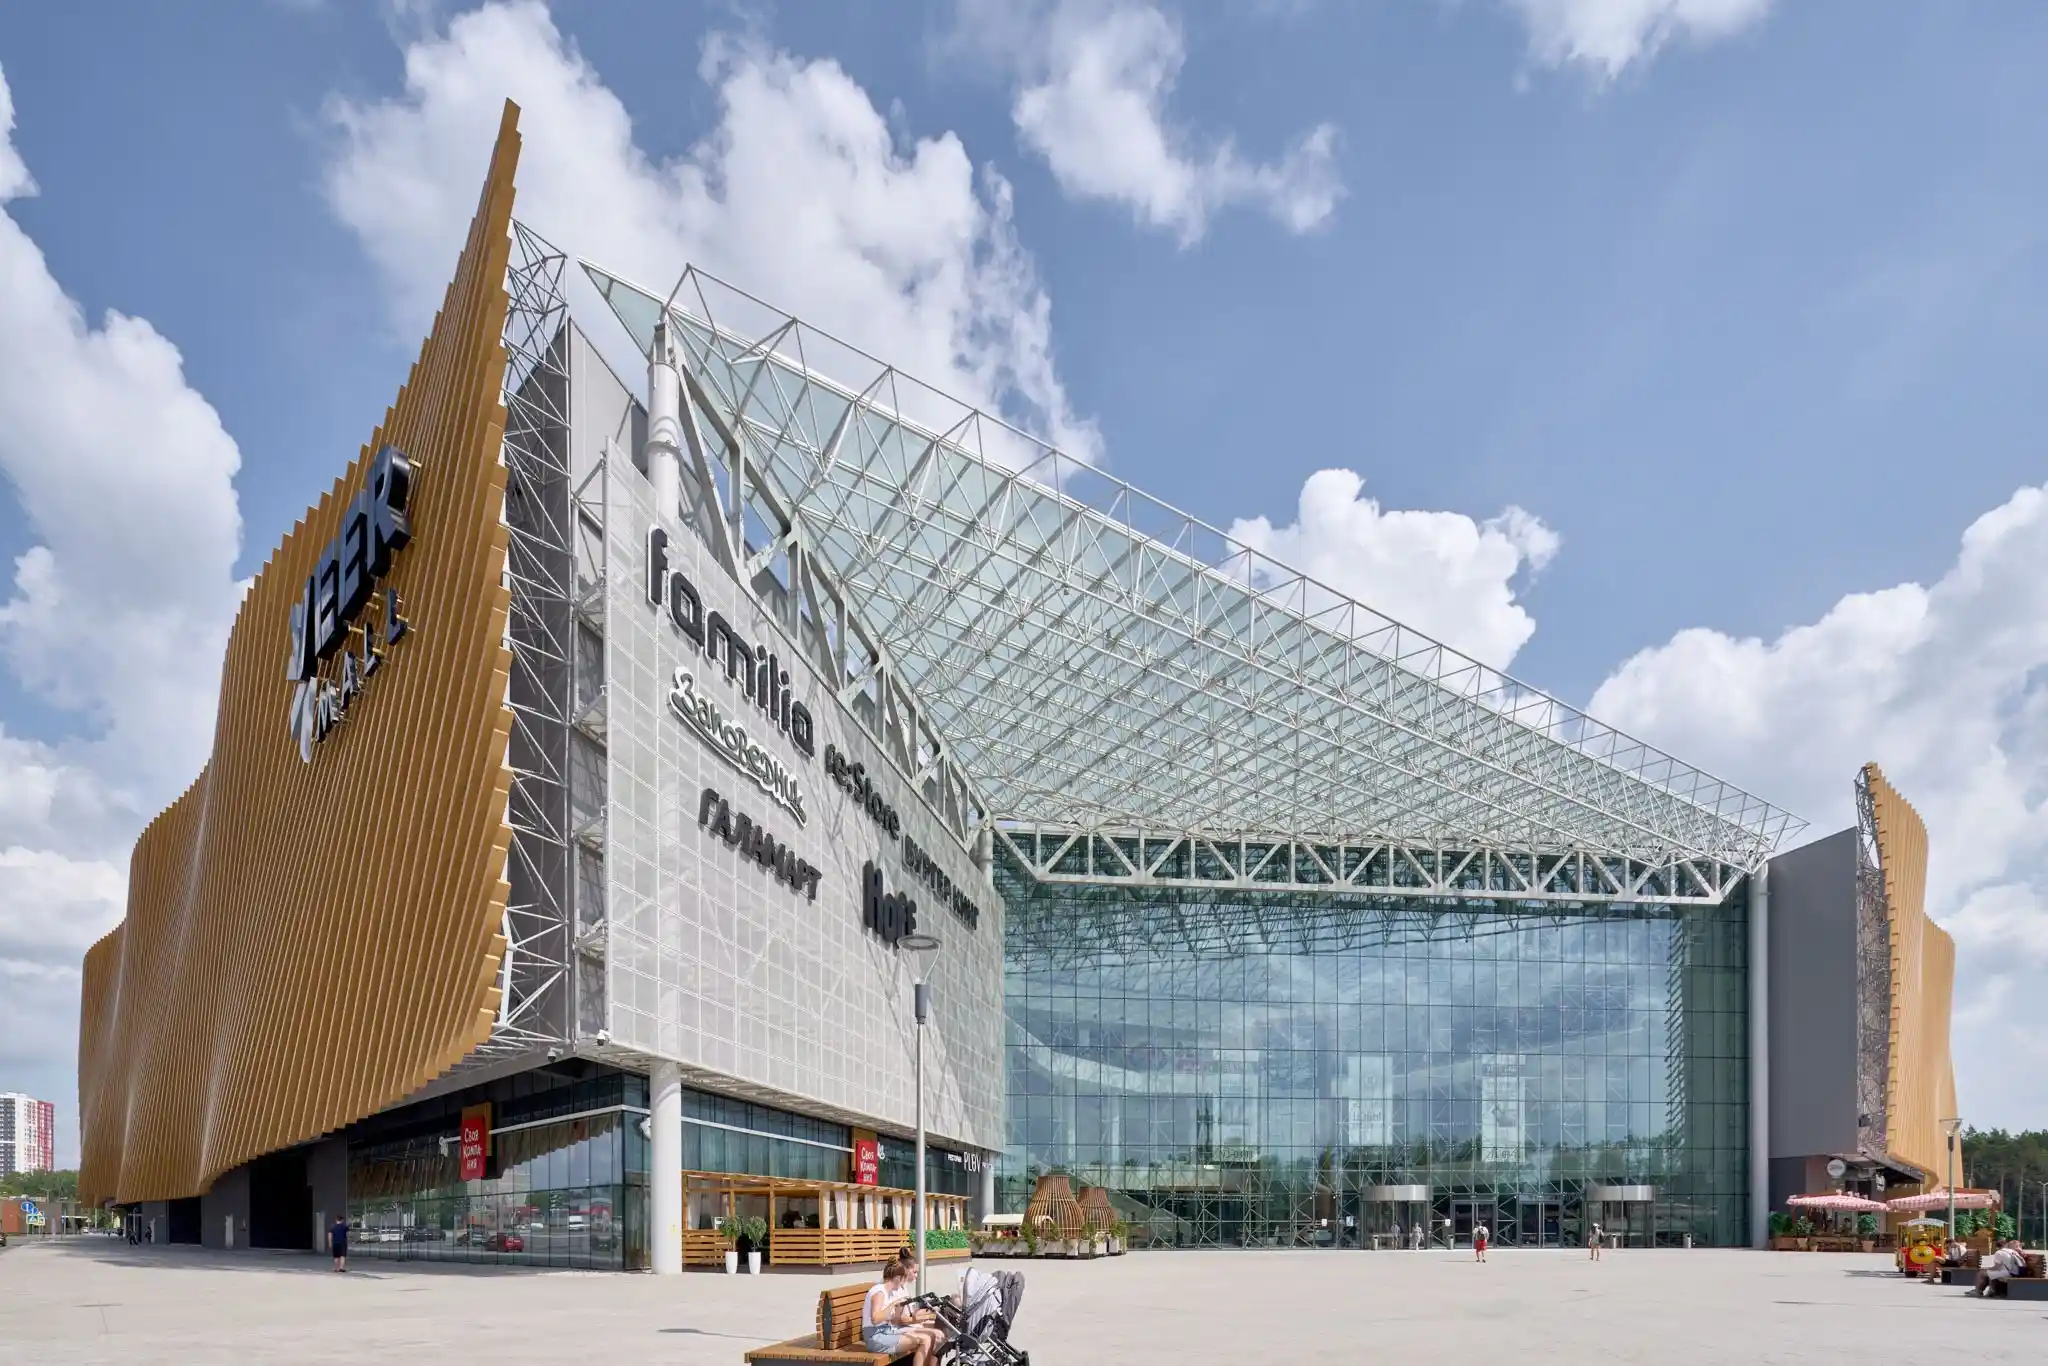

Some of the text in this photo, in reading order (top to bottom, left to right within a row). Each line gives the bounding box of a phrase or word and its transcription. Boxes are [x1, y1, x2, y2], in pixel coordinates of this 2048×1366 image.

[316, 587, 408, 743] MALL
[646, 523, 815, 759] familia
[668, 666, 808, 829] Заповедник
[824, 743, 900, 842] re:Store
[698, 787, 822, 902] ГАЛАМАРТ
[862, 859, 918, 949] Hoff
